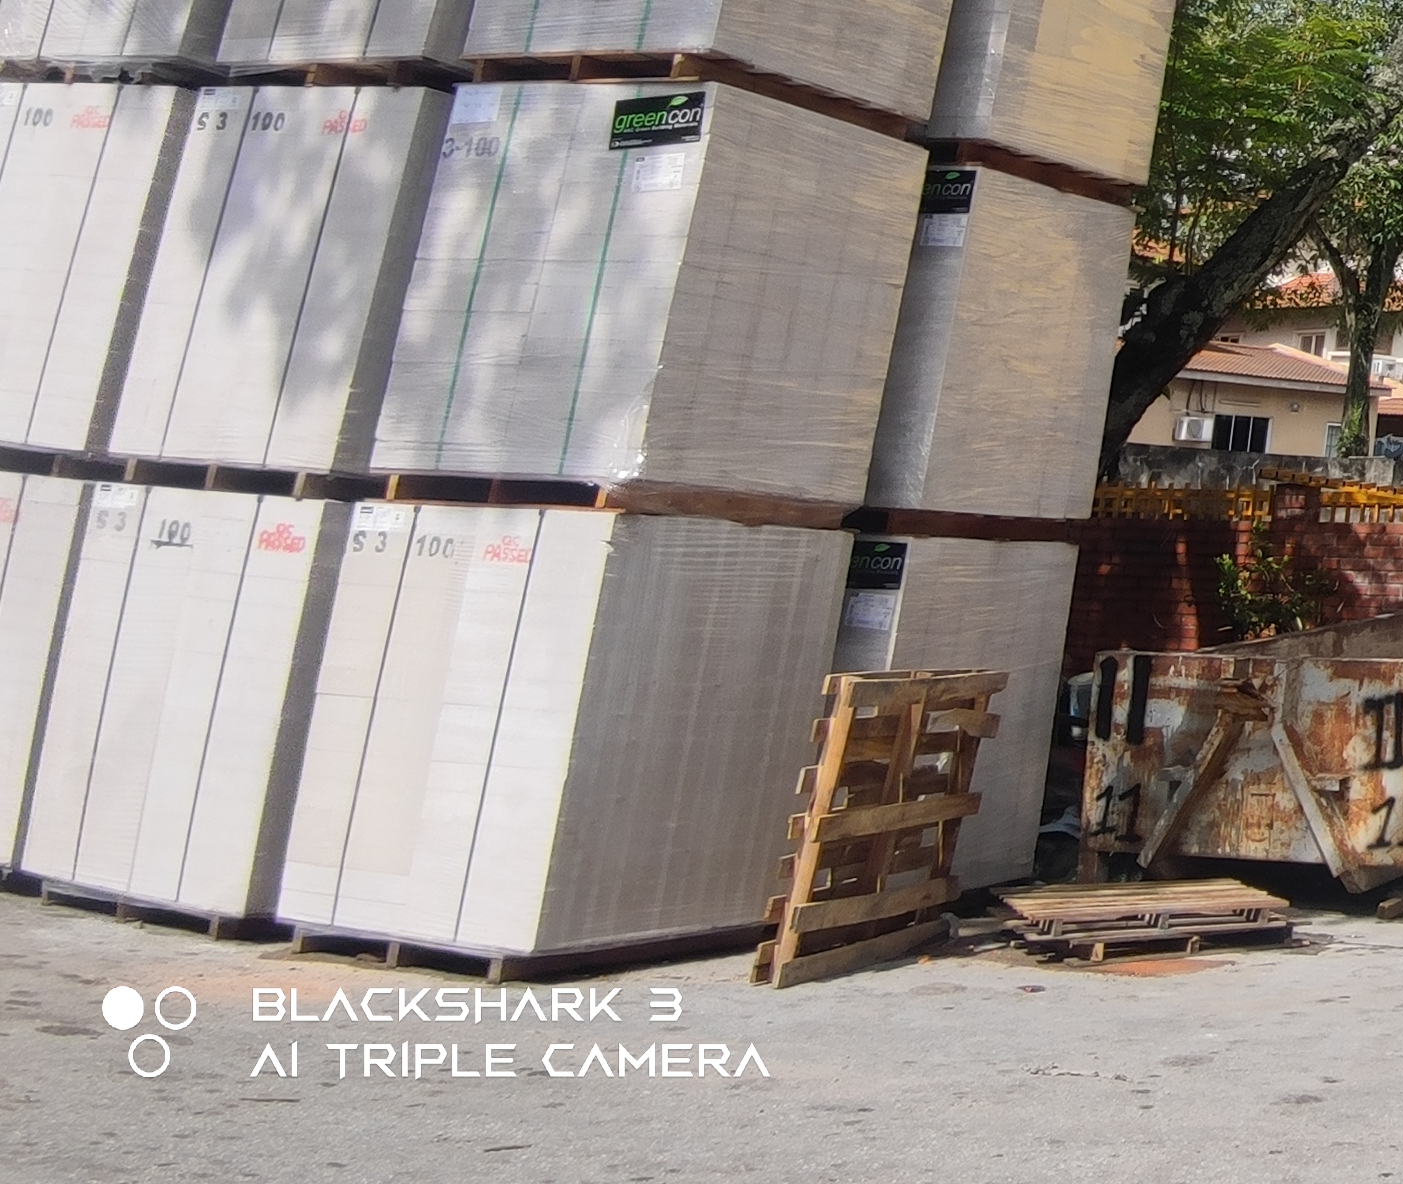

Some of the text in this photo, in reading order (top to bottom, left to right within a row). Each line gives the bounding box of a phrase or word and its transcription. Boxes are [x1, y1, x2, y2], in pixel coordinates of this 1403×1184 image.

[24, 107, 53, 127] 100
[251, 111, 285, 132] 100
[613, 107, 702, 134] greencon
[922, 183, 972, 196] encon
[353, 531, 454, 558] S 3 100
[851, 556, 902, 570] encon
[1090, 783, 1142, 842] 11
